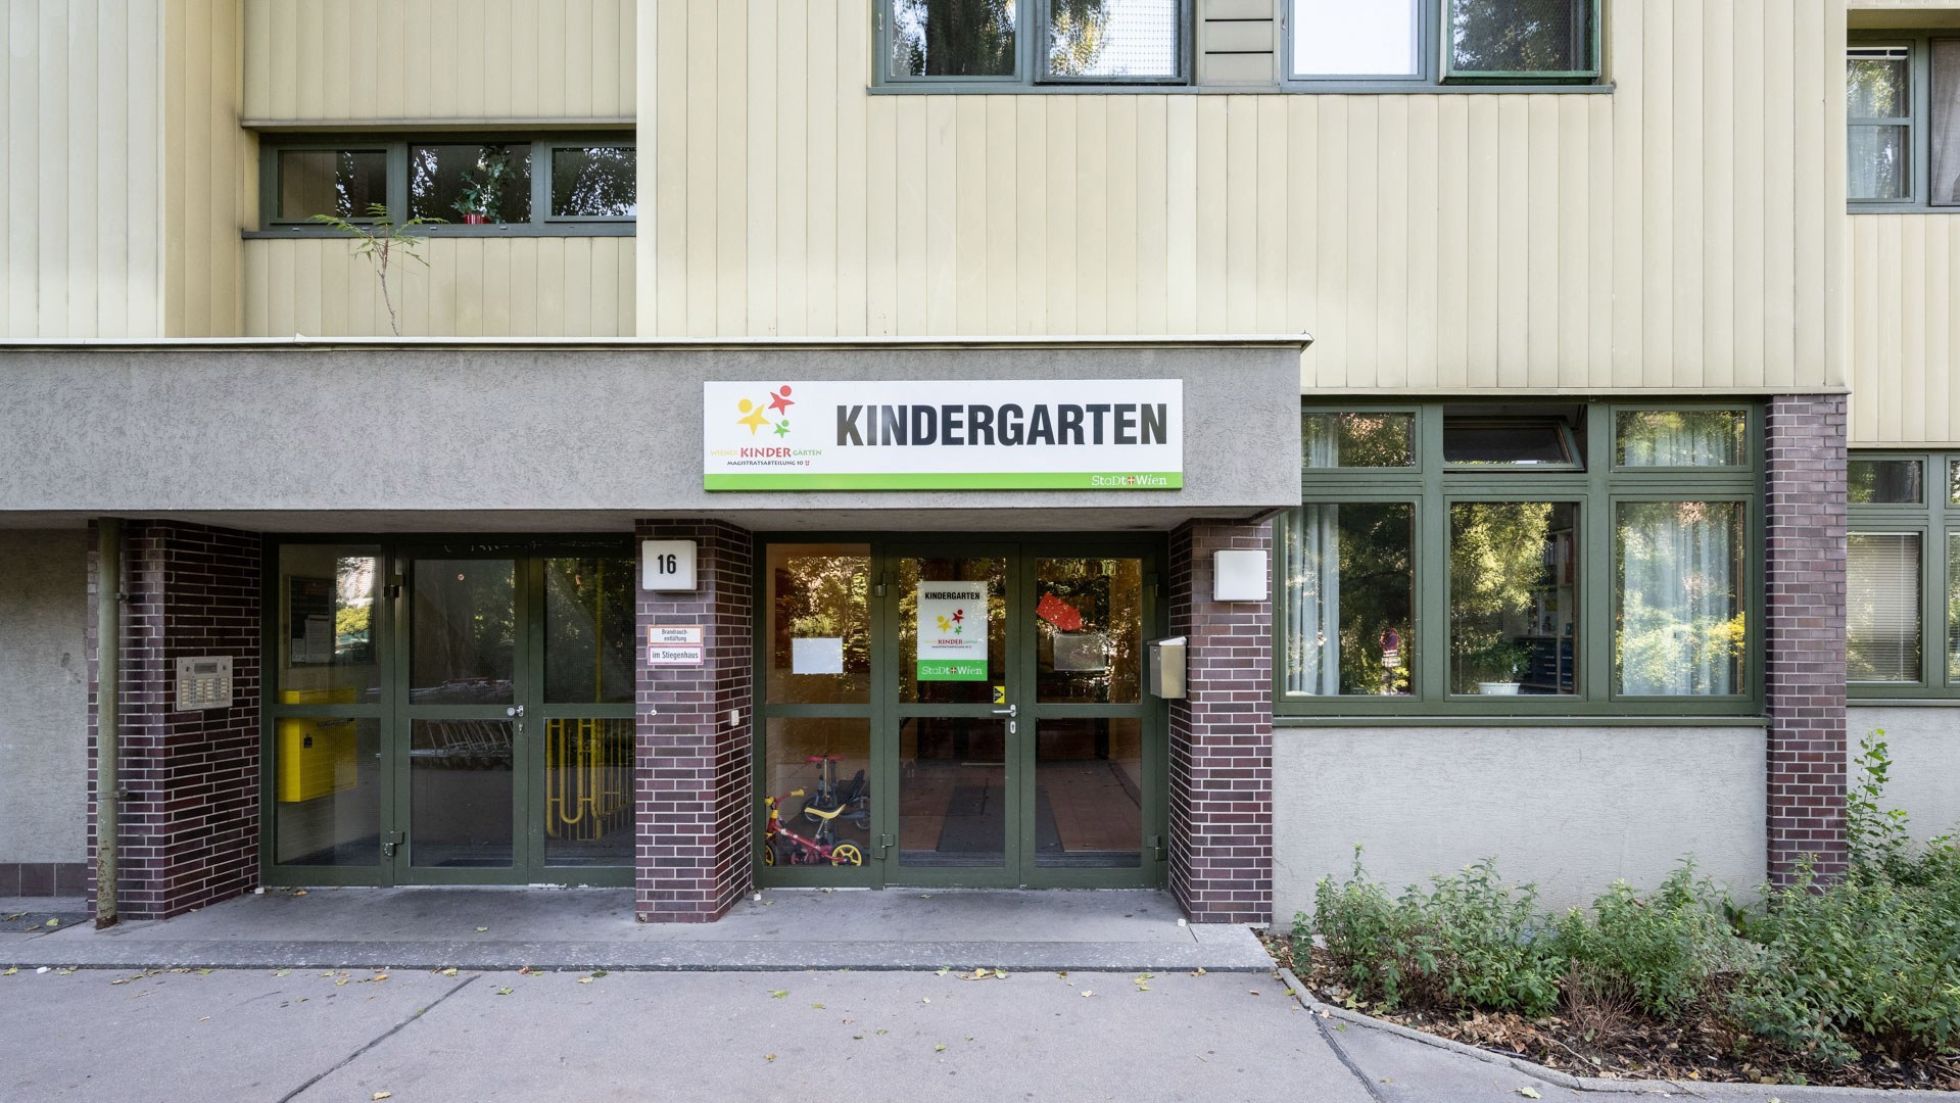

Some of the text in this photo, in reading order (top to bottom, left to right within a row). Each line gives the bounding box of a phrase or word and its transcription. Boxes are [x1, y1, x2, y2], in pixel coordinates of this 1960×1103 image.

[836, 403, 1167, 446] KINDERGARTEN
[740, 447, 792, 458] KINDER
[793, 449, 822, 457] GARTEN
[1136, 474, 1168, 486] Wien
[657, 553, 677, 575] 16
[924, 591, 980, 600] KINDERGARTEN
[652, 650, 699, 661] im Stiegenhaus
[958, 665, 983, 675] Wien
